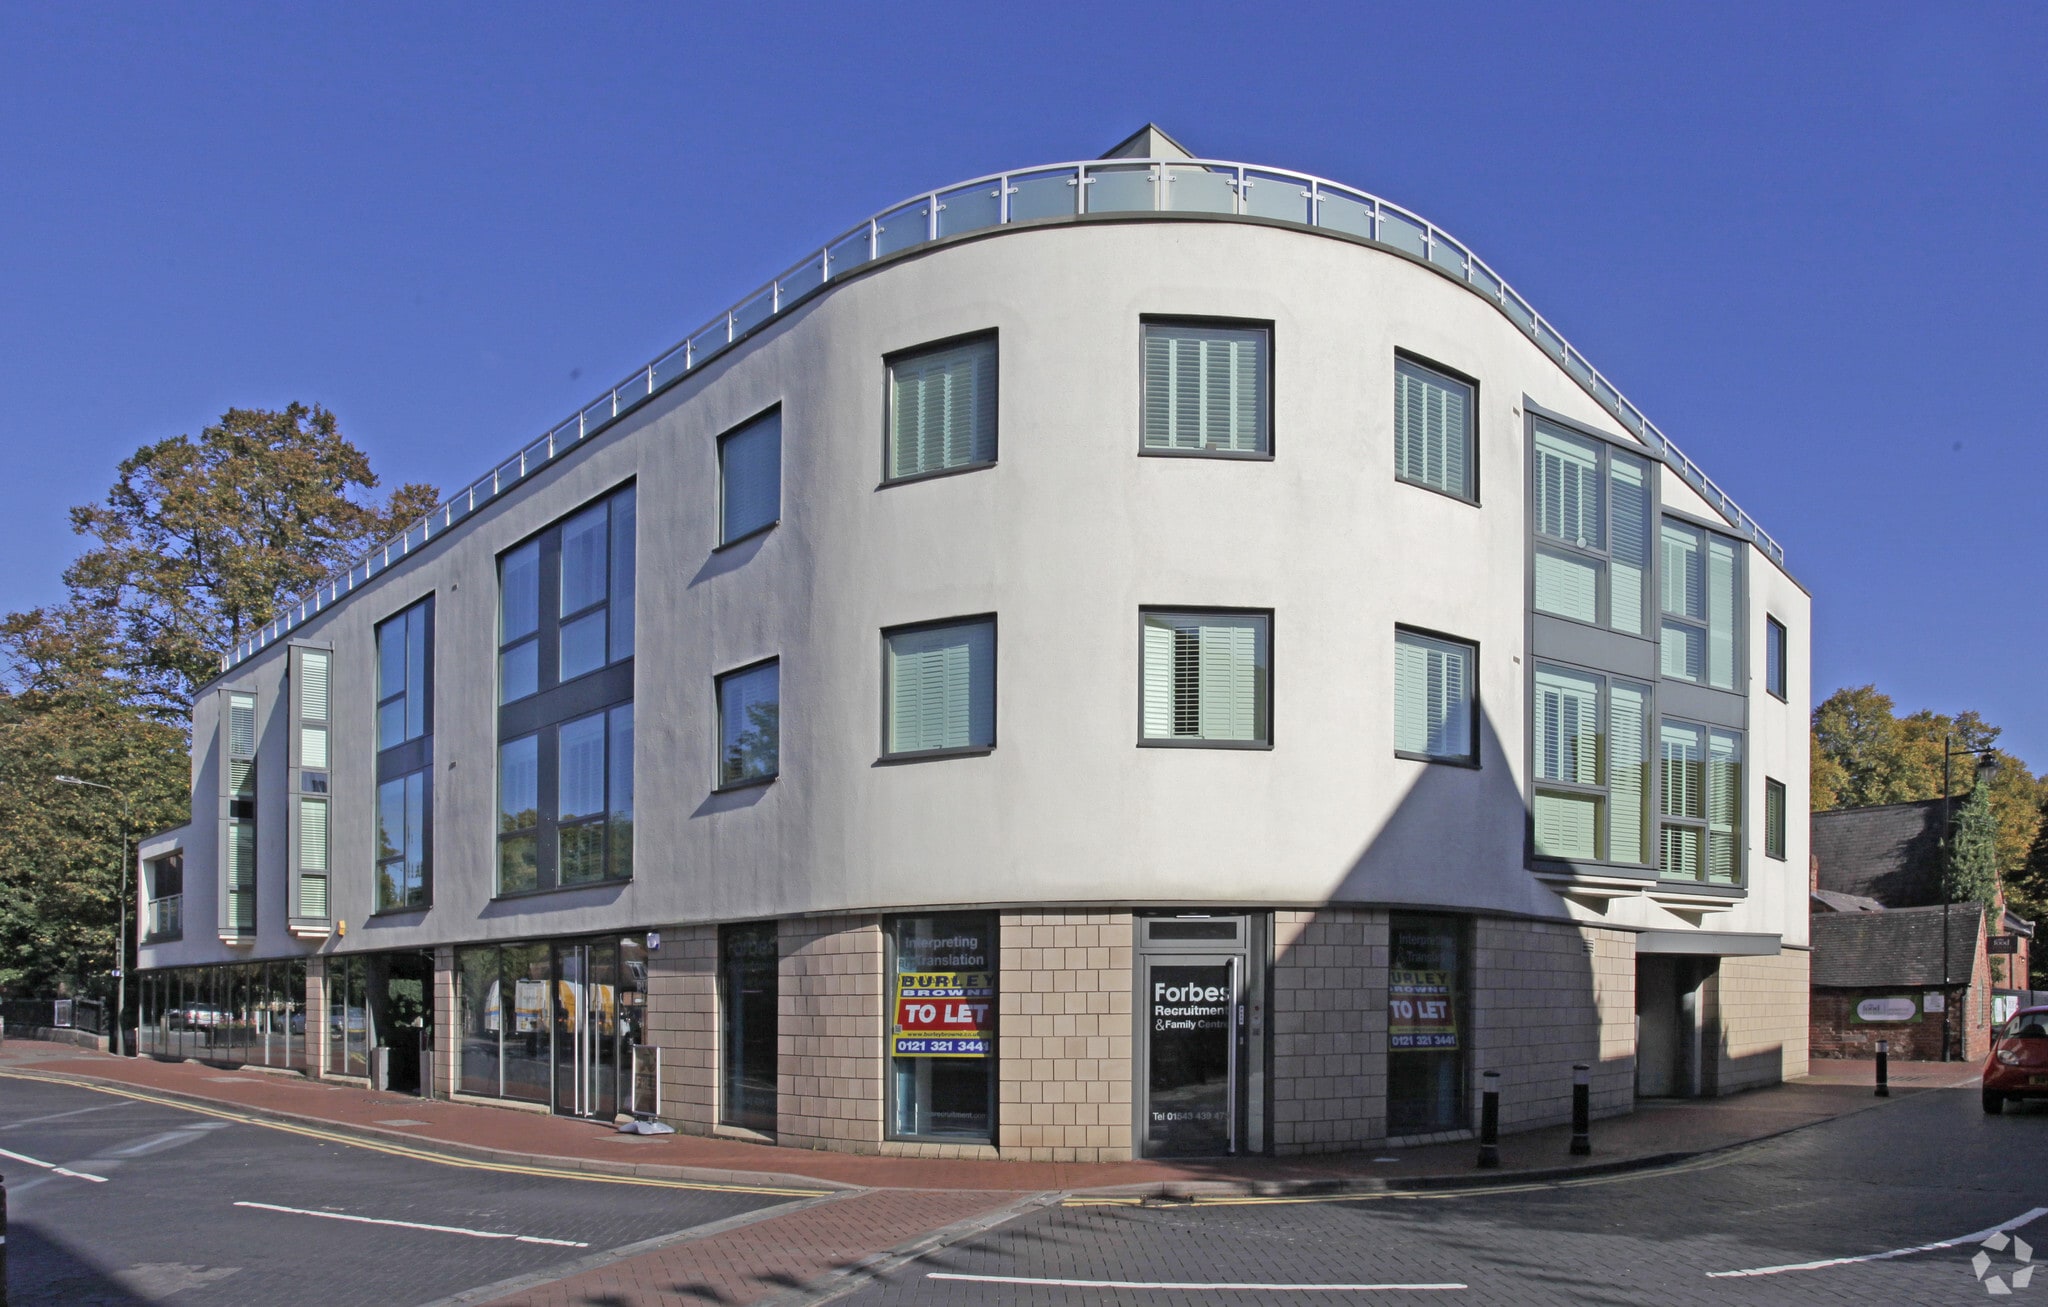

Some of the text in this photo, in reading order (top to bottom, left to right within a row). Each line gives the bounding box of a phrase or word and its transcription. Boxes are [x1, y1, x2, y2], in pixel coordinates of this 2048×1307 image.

[905, 935, 978, 950] Interpreting
[902, 975, 993, 987] BURLEY
[1392, 972, 1448, 985] URLEY
[903, 989, 993, 997] BROWNE
[1155, 982, 1230, 1002] Forbes
[905, 1004, 989, 1023] TO LET
[1390, 1000, 1447, 1019] TO LET
[897, 1041, 989, 1051] 0121 321 3441
[1392, 1035, 1456, 1046] 0121 321 3441
[1152, 1112, 1165, 1120] Tel
